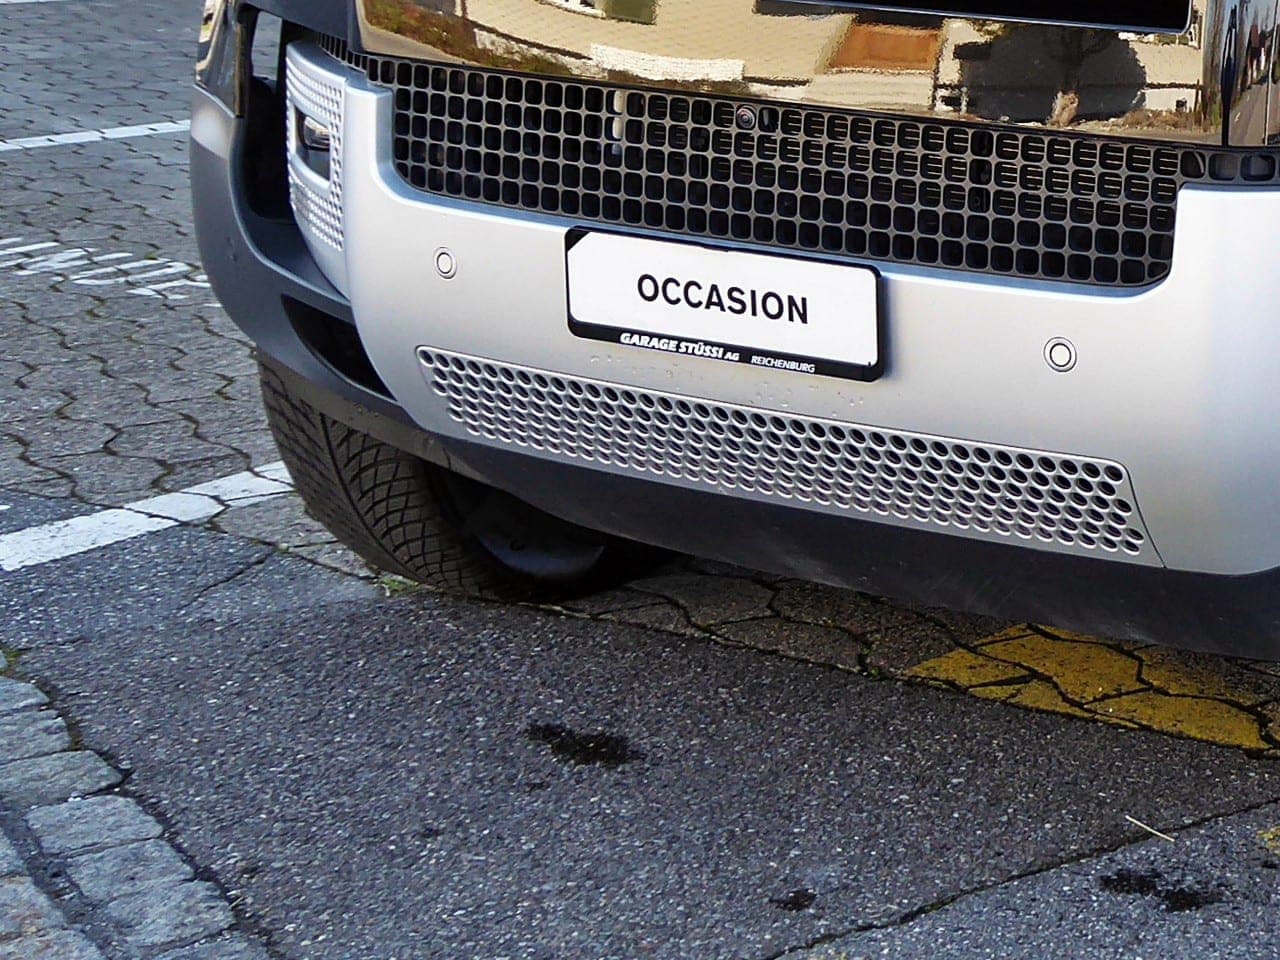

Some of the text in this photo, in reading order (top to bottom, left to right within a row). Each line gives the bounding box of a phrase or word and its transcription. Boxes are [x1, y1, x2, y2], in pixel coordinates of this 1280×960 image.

[637, 273, 809, 325] OCCASION
[620, 332, 816, 373] GARAGE STÜSSI AG REICHENBURG
